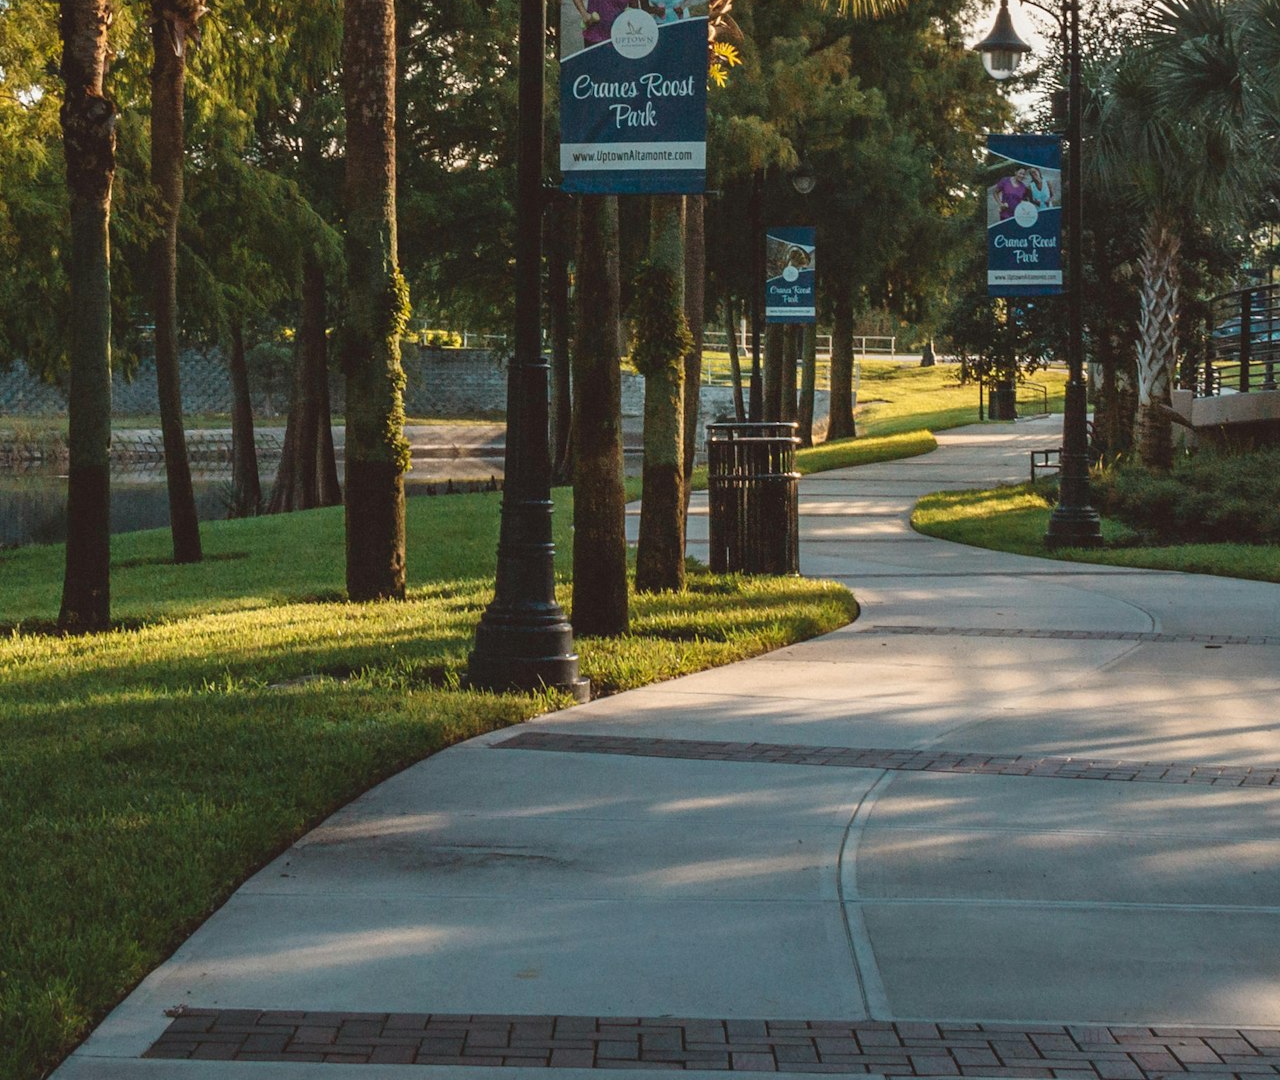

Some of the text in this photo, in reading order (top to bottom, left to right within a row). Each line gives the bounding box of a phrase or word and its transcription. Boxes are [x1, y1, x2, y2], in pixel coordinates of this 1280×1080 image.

[615, 36, 654, 44] UPTOWN
[573, 73, 695, 99] Cranes Roost
[609, 101, 658, 128] Park
[573, 150, 692, 163] www.UptownAltamonte.com
[994, 234, 1028, 248] Cranes
[1013, 249, 1039, 264] Park
